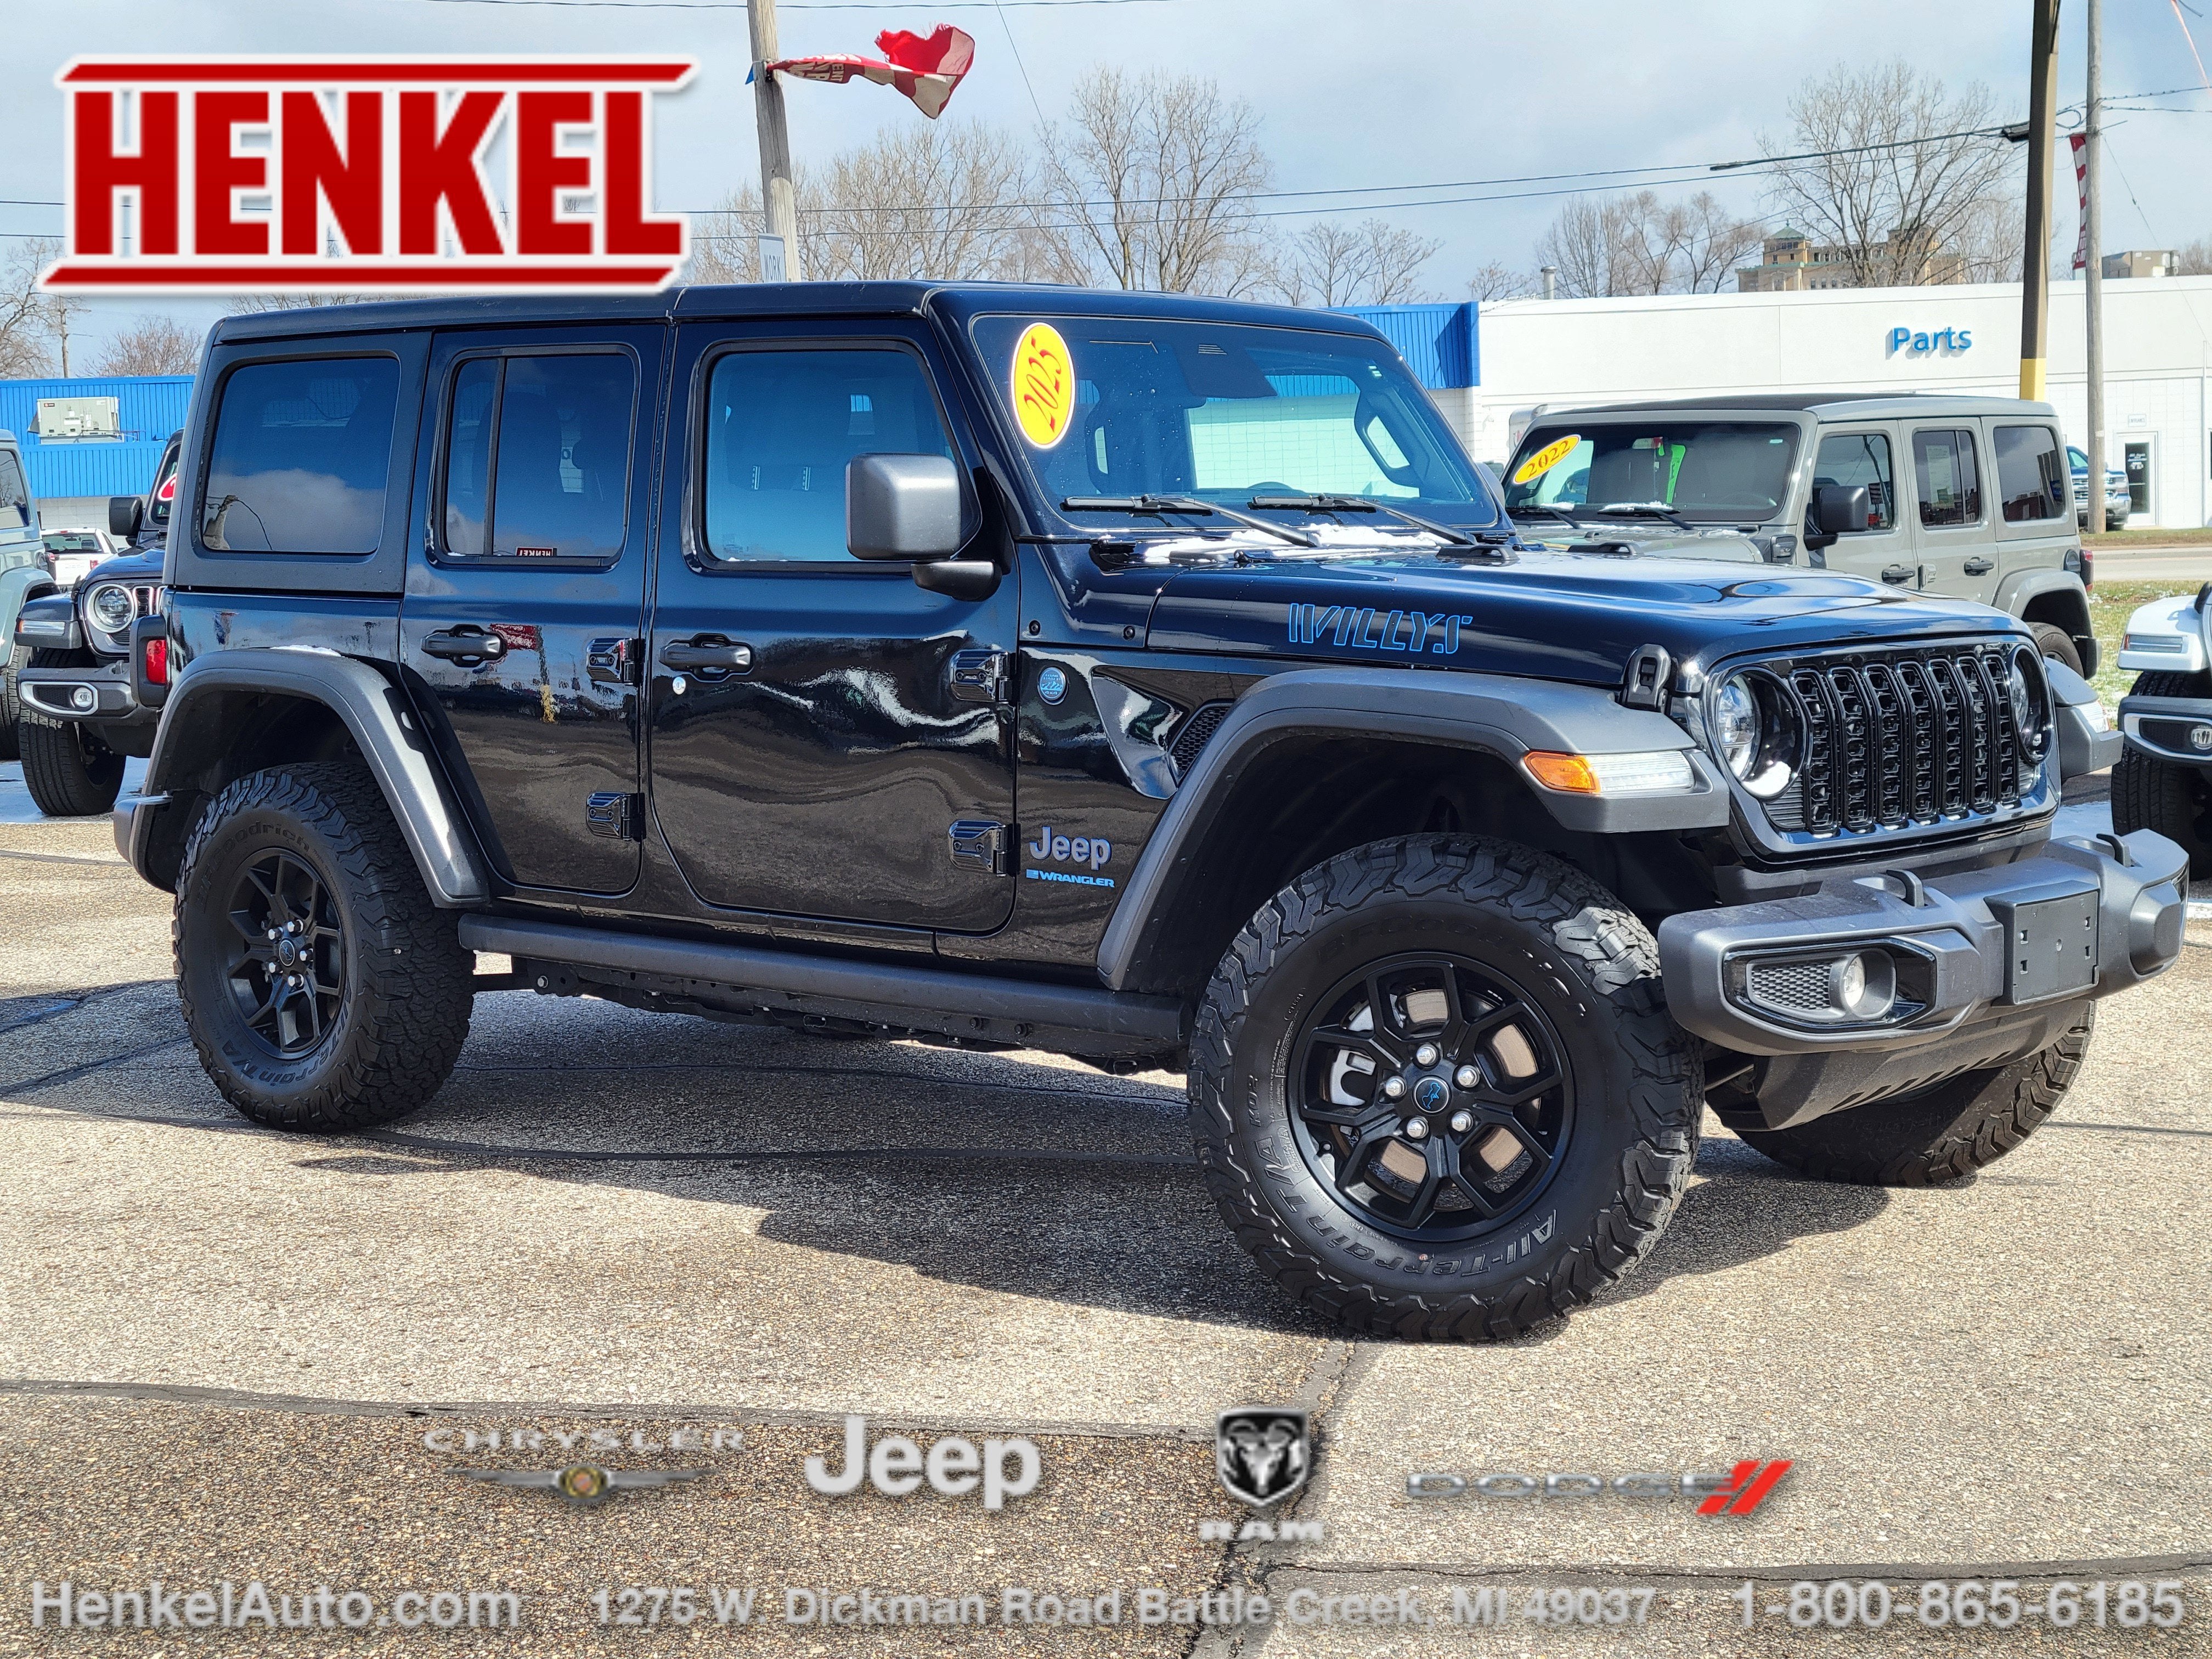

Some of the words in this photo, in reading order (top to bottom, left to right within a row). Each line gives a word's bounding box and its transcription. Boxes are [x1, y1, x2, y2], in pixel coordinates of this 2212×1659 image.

[764, 254, 782, 282] WORK
[1893, 326, 1973, 352] Parts
[1024, 335, 1062, 433] 2025
[1526, 440, 1571, 478] 2022
[1289, 602, 1474, 654] WILLYS
[1029, 826, 1111, 871] Jeep
[1039, 870, 1115, 888] WRANGLER
[1254, 1135, 1308, 1213] T/A
[1306, 1209, 1557, 1277] All-Terrain
